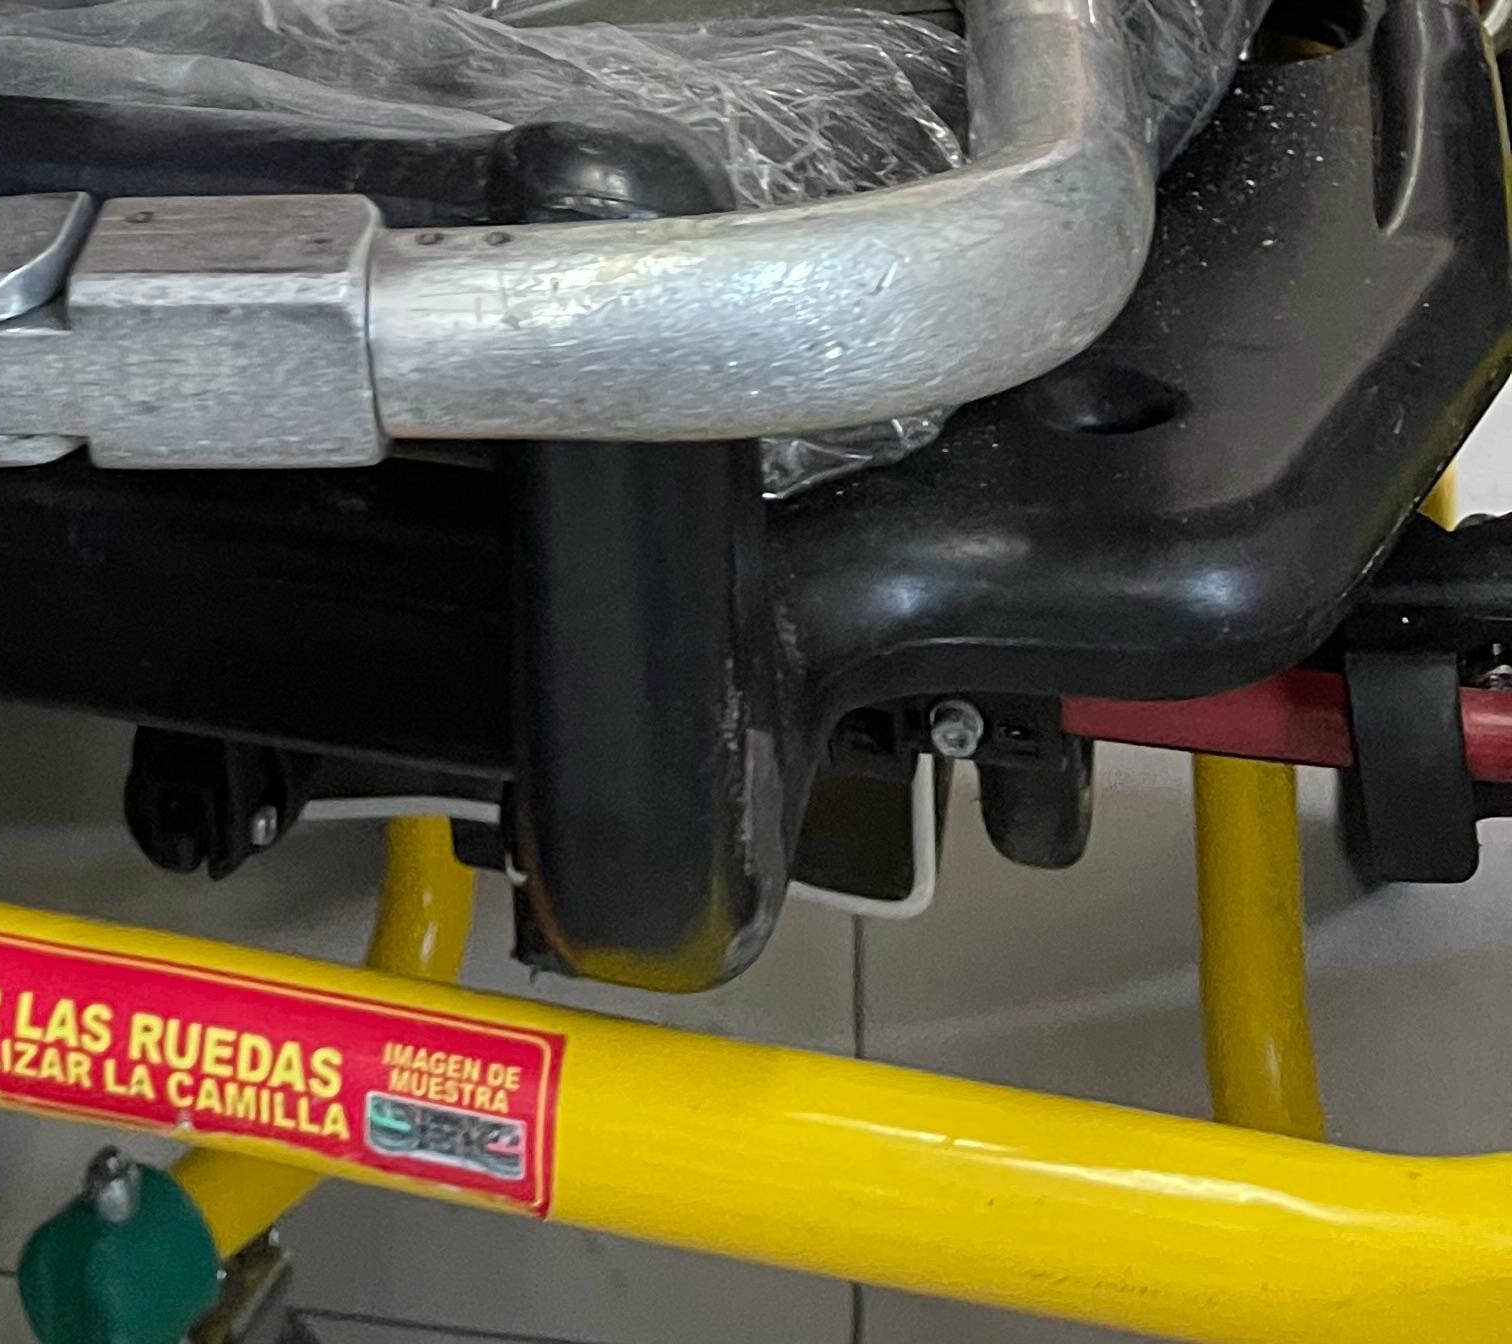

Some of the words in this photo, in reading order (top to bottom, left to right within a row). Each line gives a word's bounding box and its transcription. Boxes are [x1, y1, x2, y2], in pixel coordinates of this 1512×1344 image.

[15, 991, 113, 1053] LAS
[128, 1012, 343, 1099] RUEDAS
[382, 1041, 482, 1082] IMAGEN
[487, 1063, 522, 1090] DE
[103, 1059, 156, 1101] LA
[166, 1071, 350, 1140] CAMILLA
[389, 1068, 509, 1114] MUESTRA
